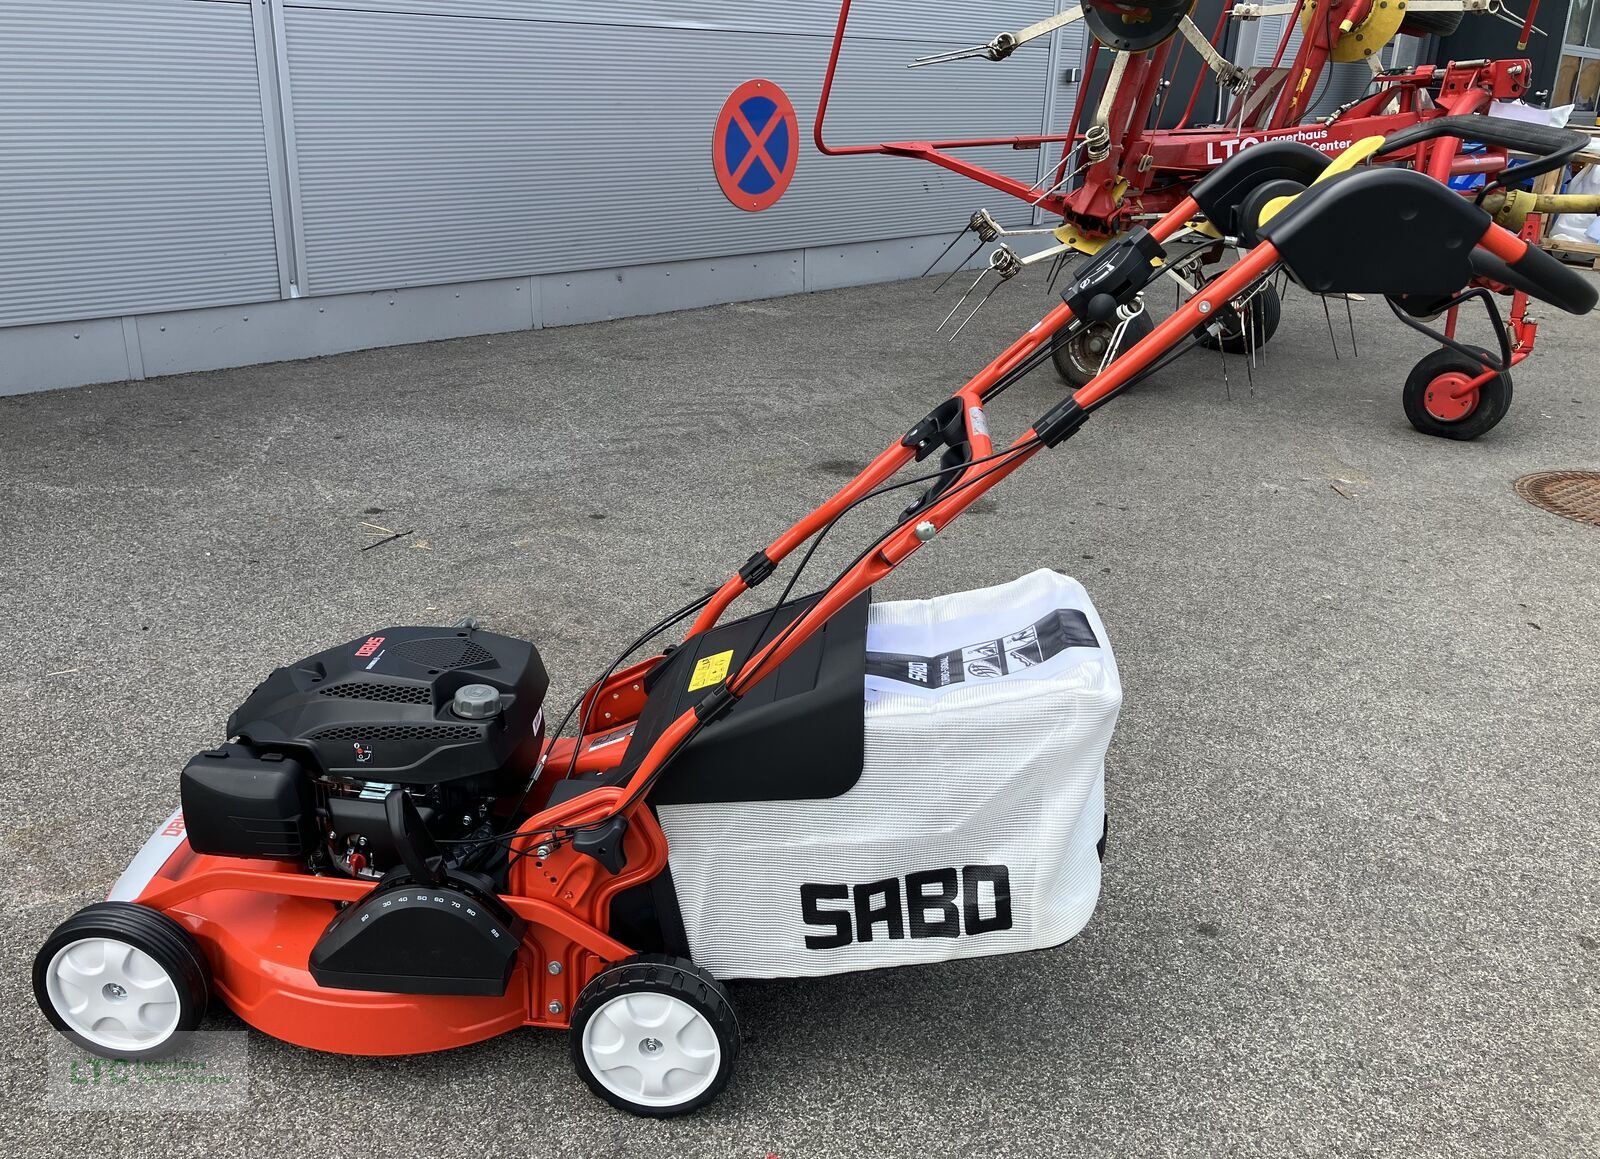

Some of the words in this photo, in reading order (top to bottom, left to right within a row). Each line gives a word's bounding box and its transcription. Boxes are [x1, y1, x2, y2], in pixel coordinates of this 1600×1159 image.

[355, 636, 386, 657] SABO
[907, 661, 928, 683] SABO
[466, 908, 476, 916] 80
[800, 865, 1012, 950] SABO
